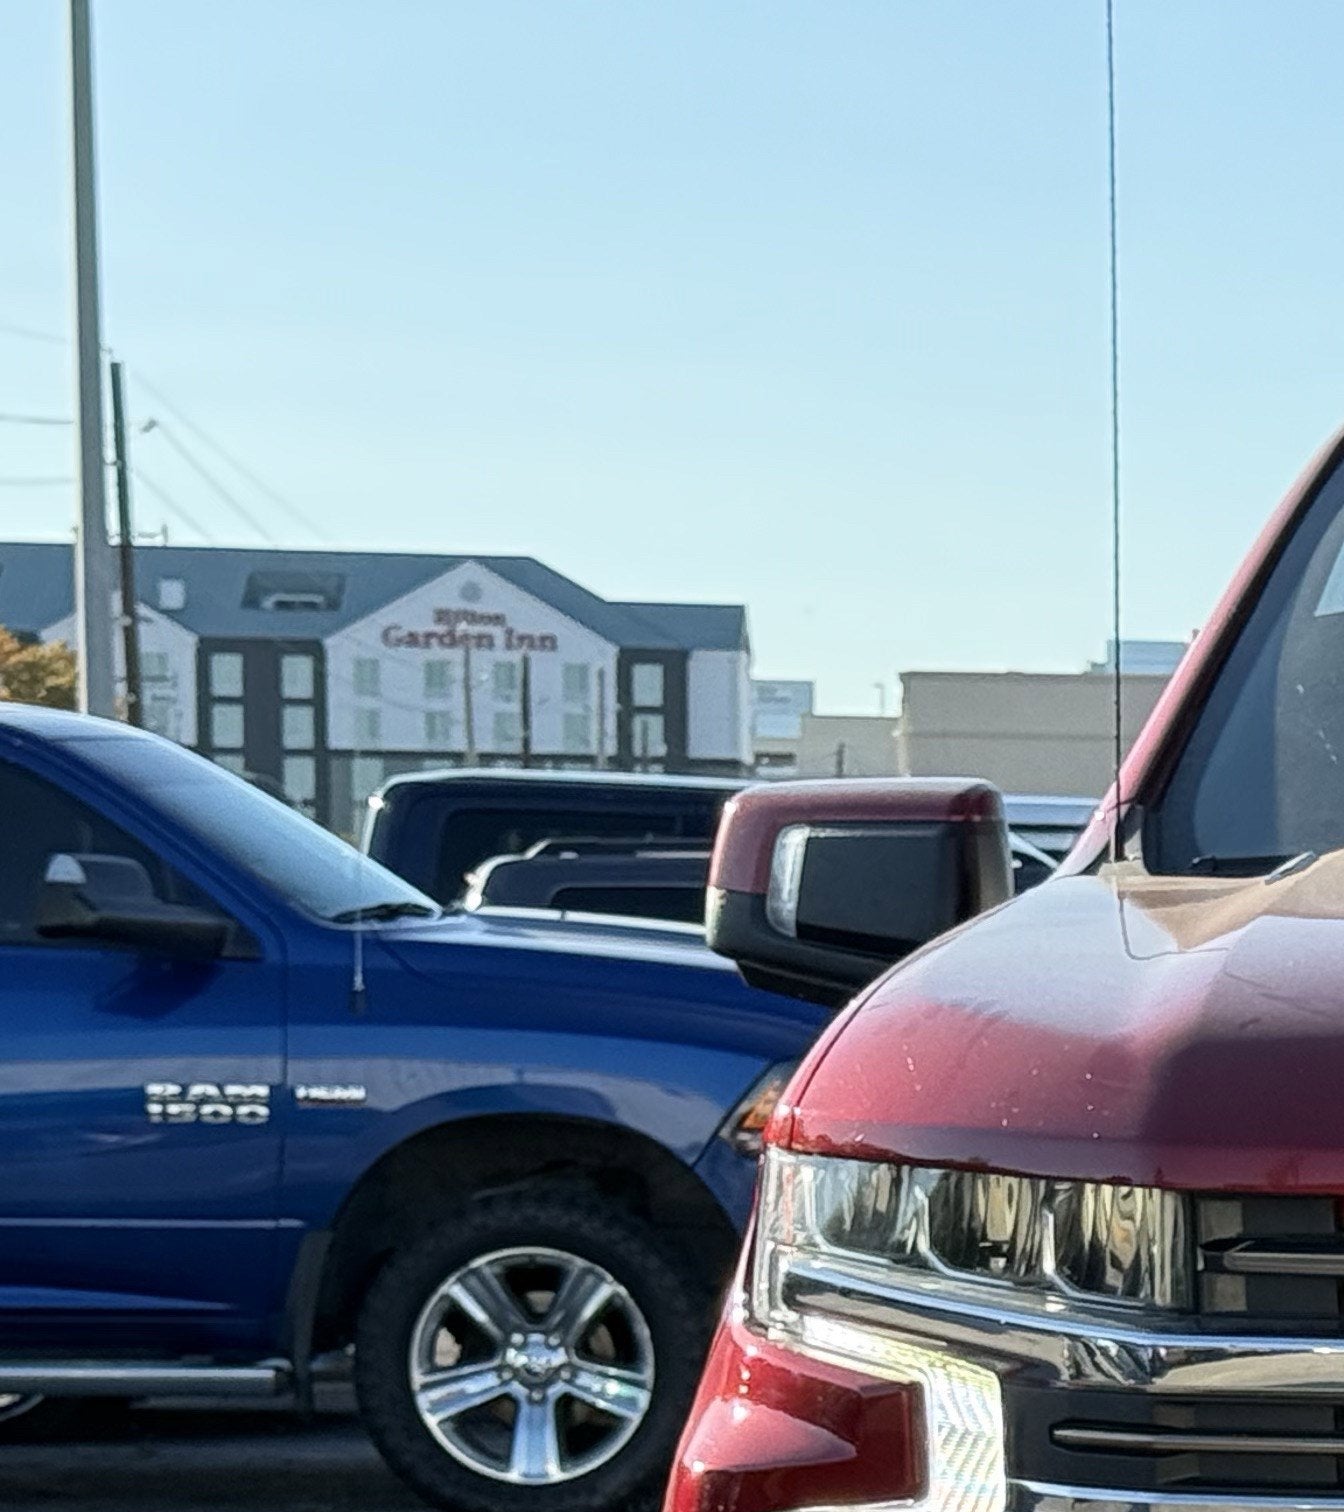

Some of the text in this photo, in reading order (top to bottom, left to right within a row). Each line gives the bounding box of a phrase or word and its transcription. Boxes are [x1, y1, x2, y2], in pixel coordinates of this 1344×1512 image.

[381, 623, 559, 651] Garden Inn
[145, 1083, 271, 1103] RAM
[145, 1103, 271, 1124] 1500
